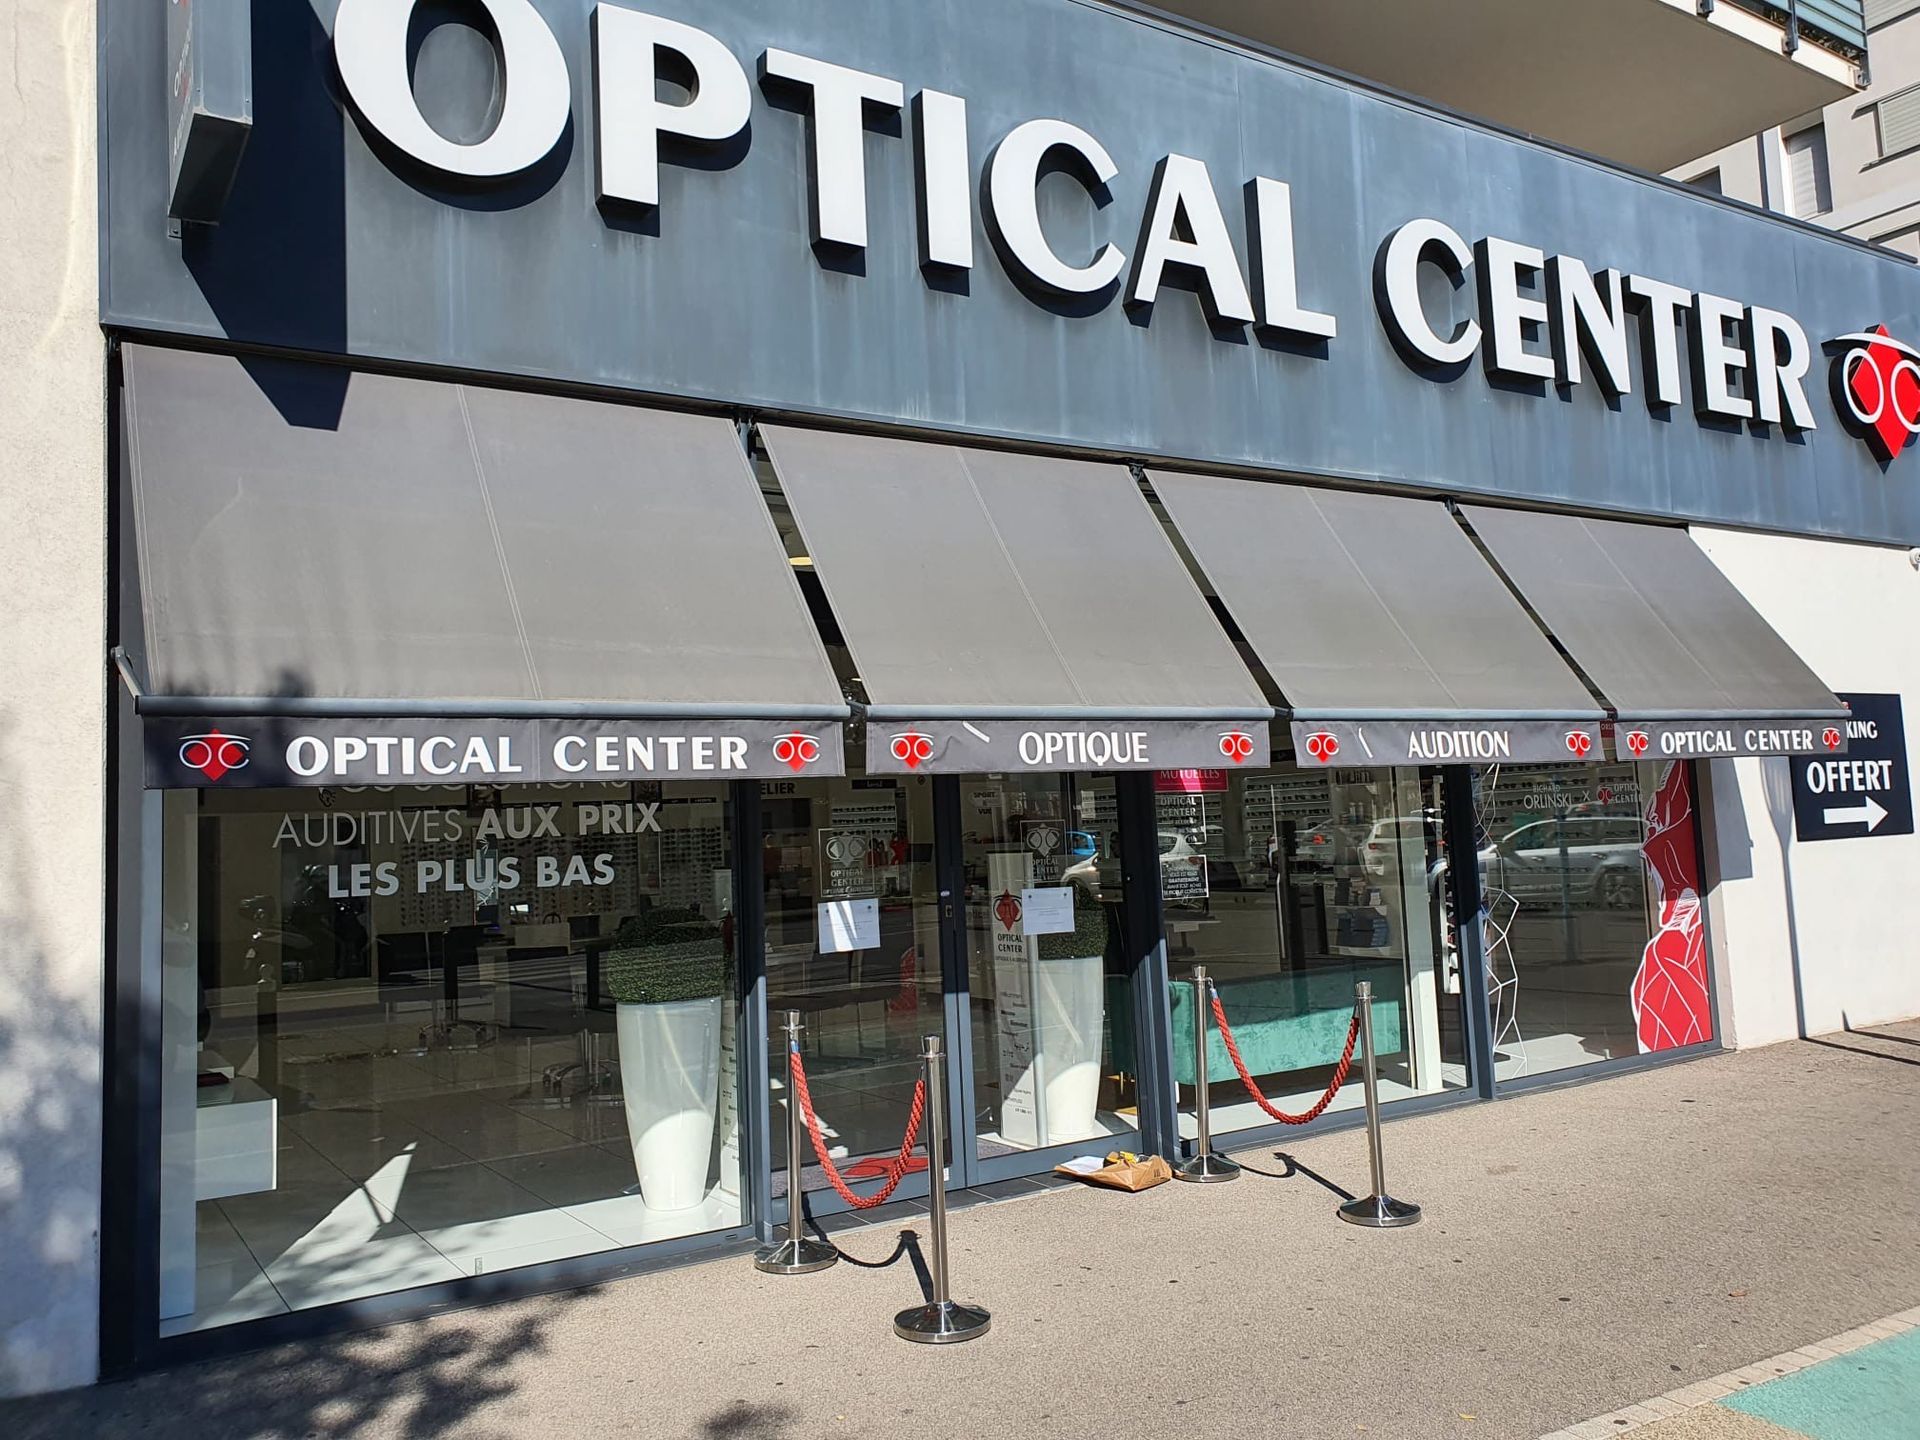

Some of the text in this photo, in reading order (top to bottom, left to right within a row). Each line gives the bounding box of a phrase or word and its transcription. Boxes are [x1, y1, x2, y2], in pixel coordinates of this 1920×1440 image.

[333, 0, 1816, 430] OPTICAL CENTER
[285, 735, 748, 776] OPTICAL CENTER
[1018, 731, 1149, 766] OPTIQUE
[1408, 730, 1510, 758] AUDITION
[1660, 729, 1814, 755] OPTICAL CENTER
[1806, 759, 1893, 794] OFFERT
[1161, 807, 1197, 817] CENTER
[1523, 792, 1572, 810] ORLINSKI
[272, 801, 662, 849] AUDITIVES AUX PRIX
[328, 852, 616, 899] LES PLUS BAS
[997, 932, 1023, 943] OPTICAL
[998, 943, 1023, 953] CENTER
